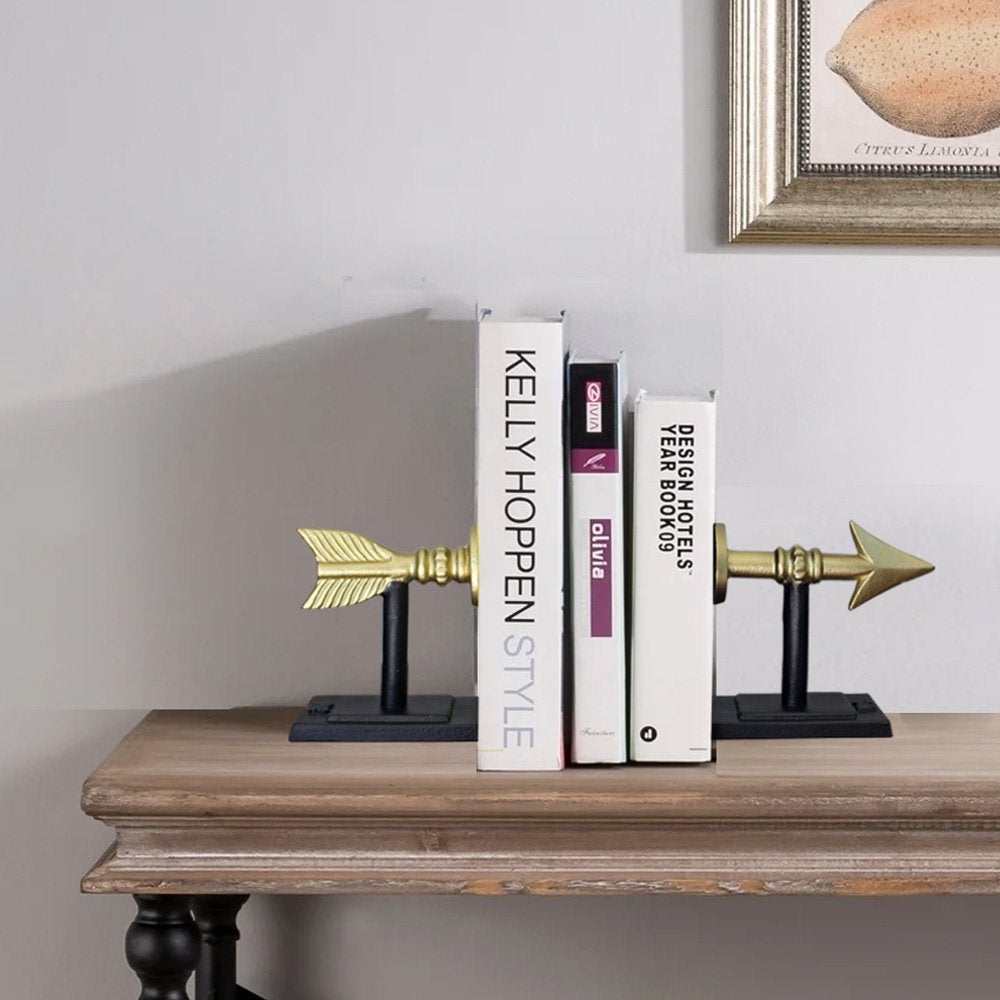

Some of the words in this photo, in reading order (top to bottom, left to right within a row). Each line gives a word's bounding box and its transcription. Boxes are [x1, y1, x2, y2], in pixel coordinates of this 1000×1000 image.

[504, 350, 536, 461] KELLY
[660, 424, 676, 471] YEAR
[677, 424, 694, 491] DESIGN
[504, 470, 536, 622] HOPPEN
[592, 523, 609, 579] olivia
[503, 636, 535, 750] STYLE
